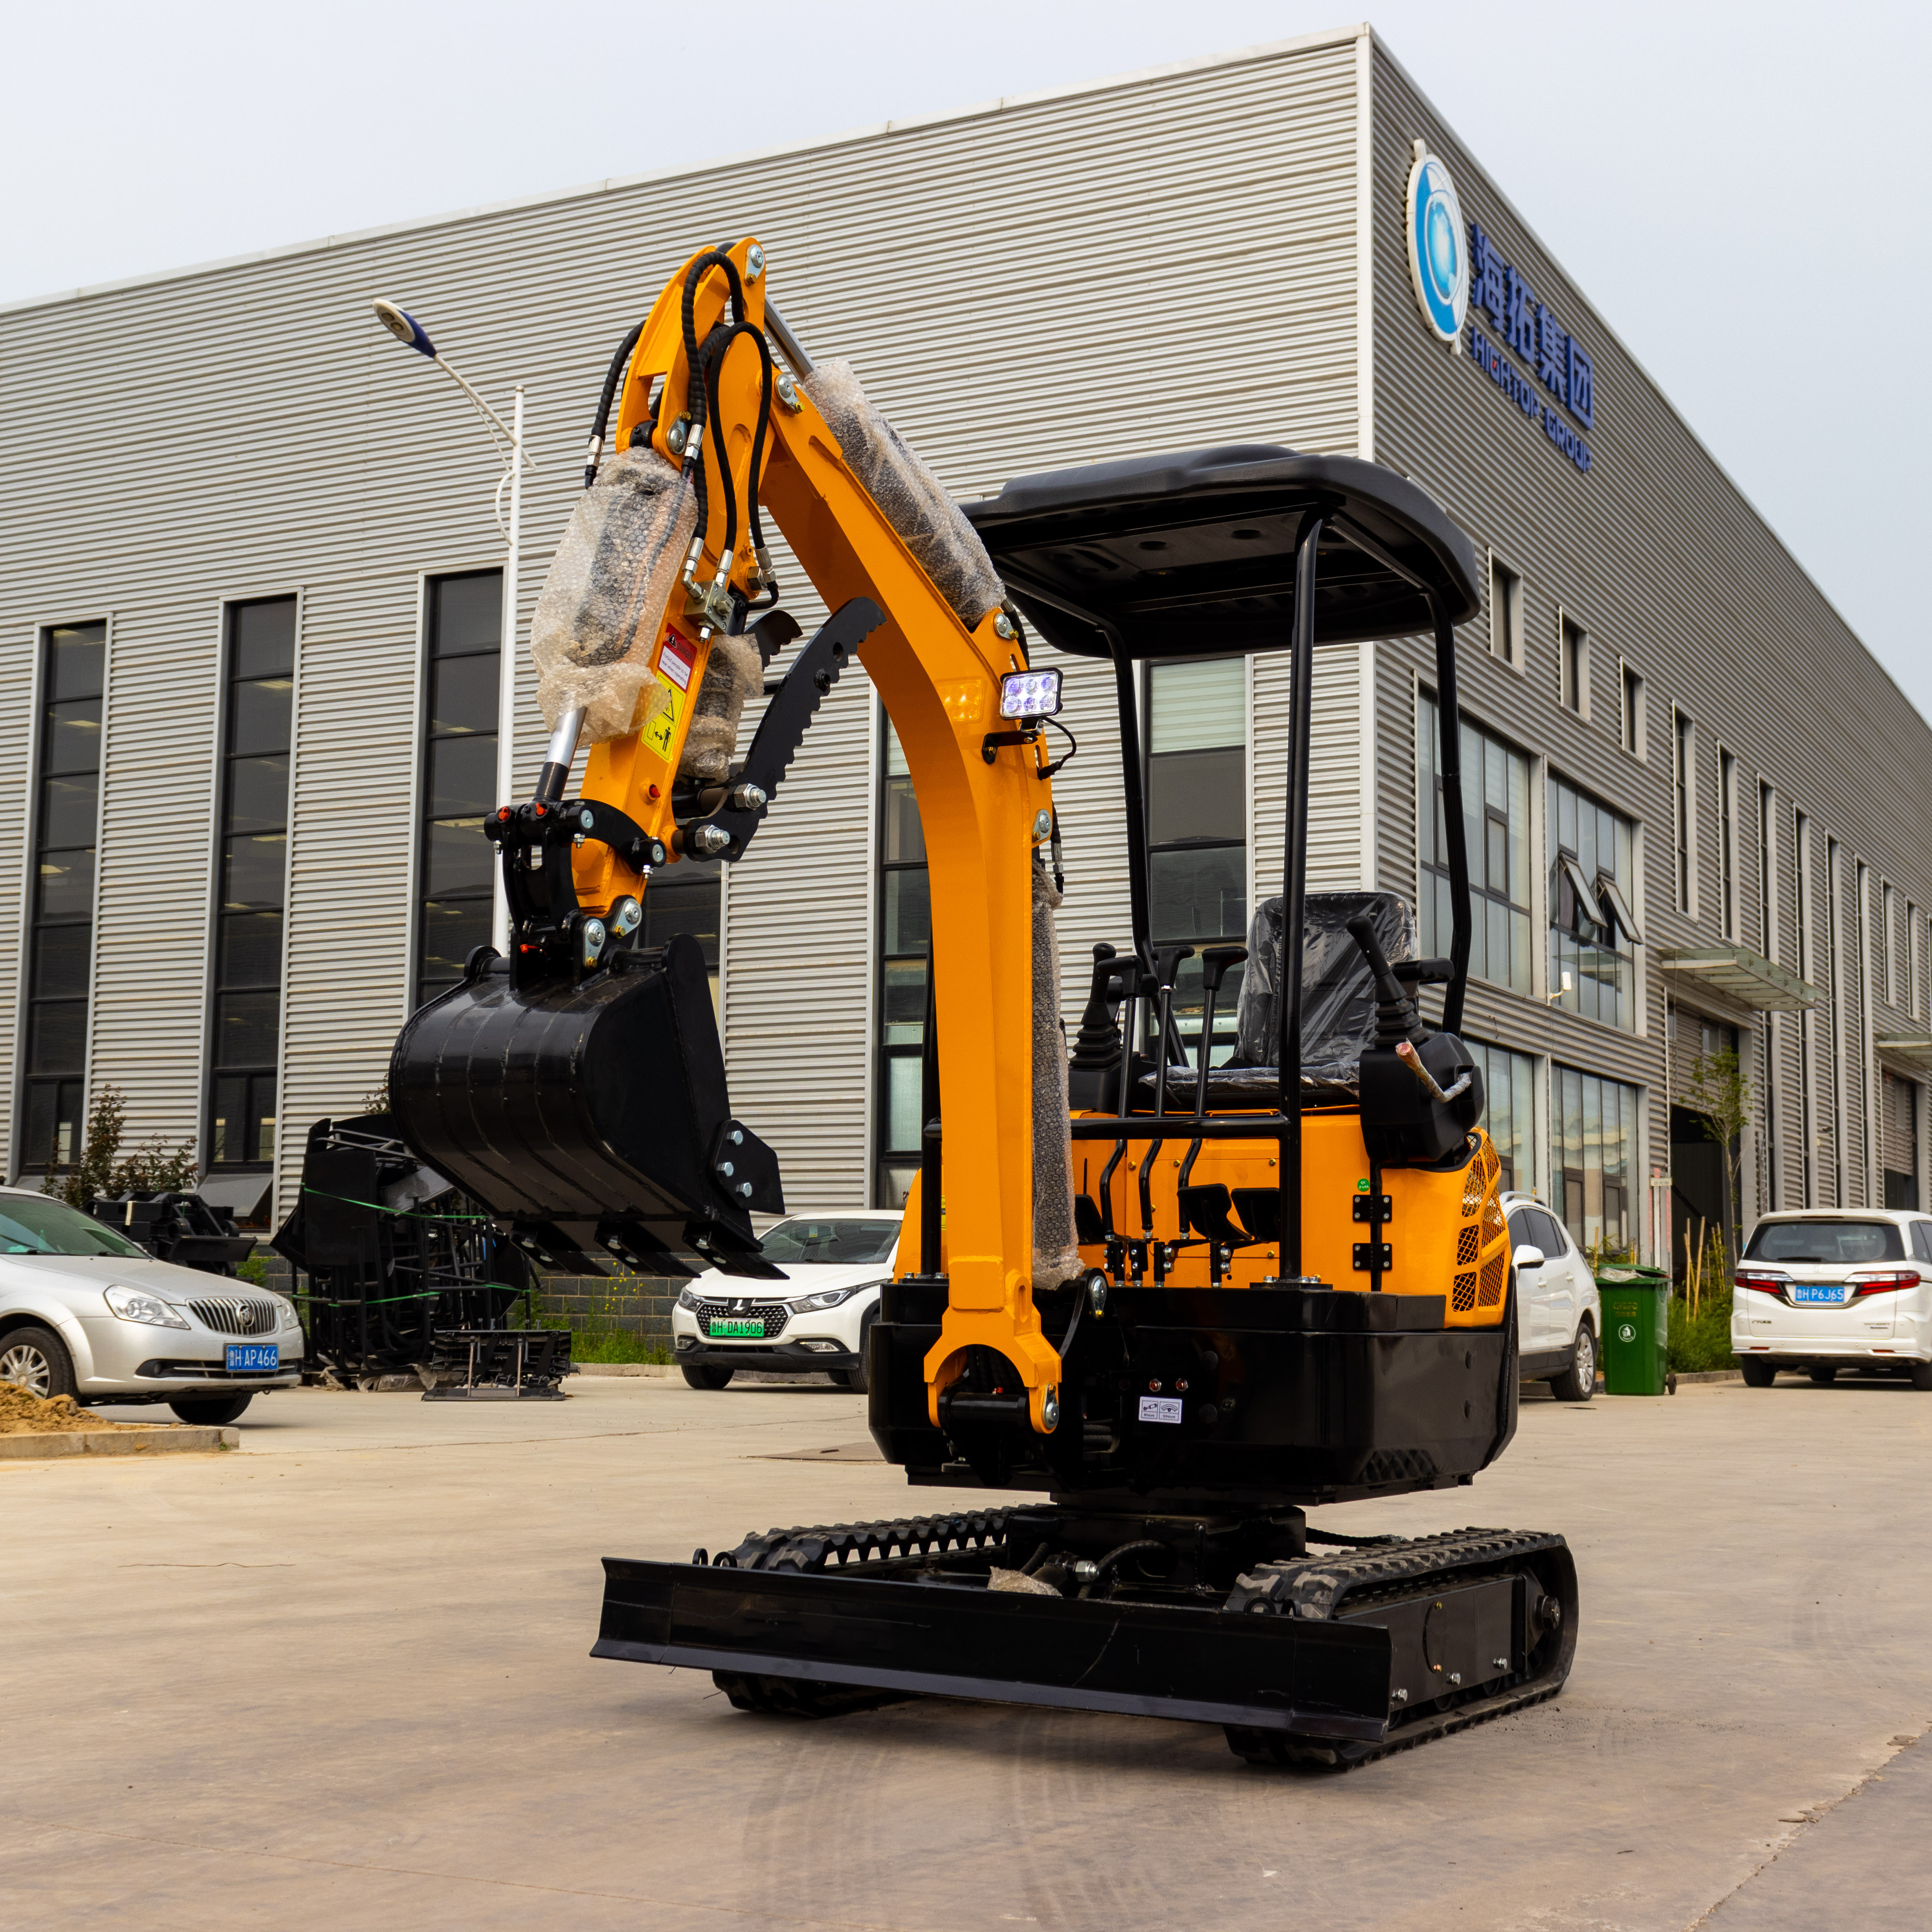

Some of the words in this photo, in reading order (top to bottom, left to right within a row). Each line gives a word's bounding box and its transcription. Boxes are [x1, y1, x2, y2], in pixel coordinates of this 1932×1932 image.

[1472, 224, 1593, 430] 海拓集团
[1472, 326, 1540, 418] HIGHTOP
[1545, 407, 1592, 473] GROUP
[677, 642, 694, 661] DANGER
[663, 652, 672, 663] Forbid
[671, 661, 681, 671] people
[674, 671, 687, 685] operating
